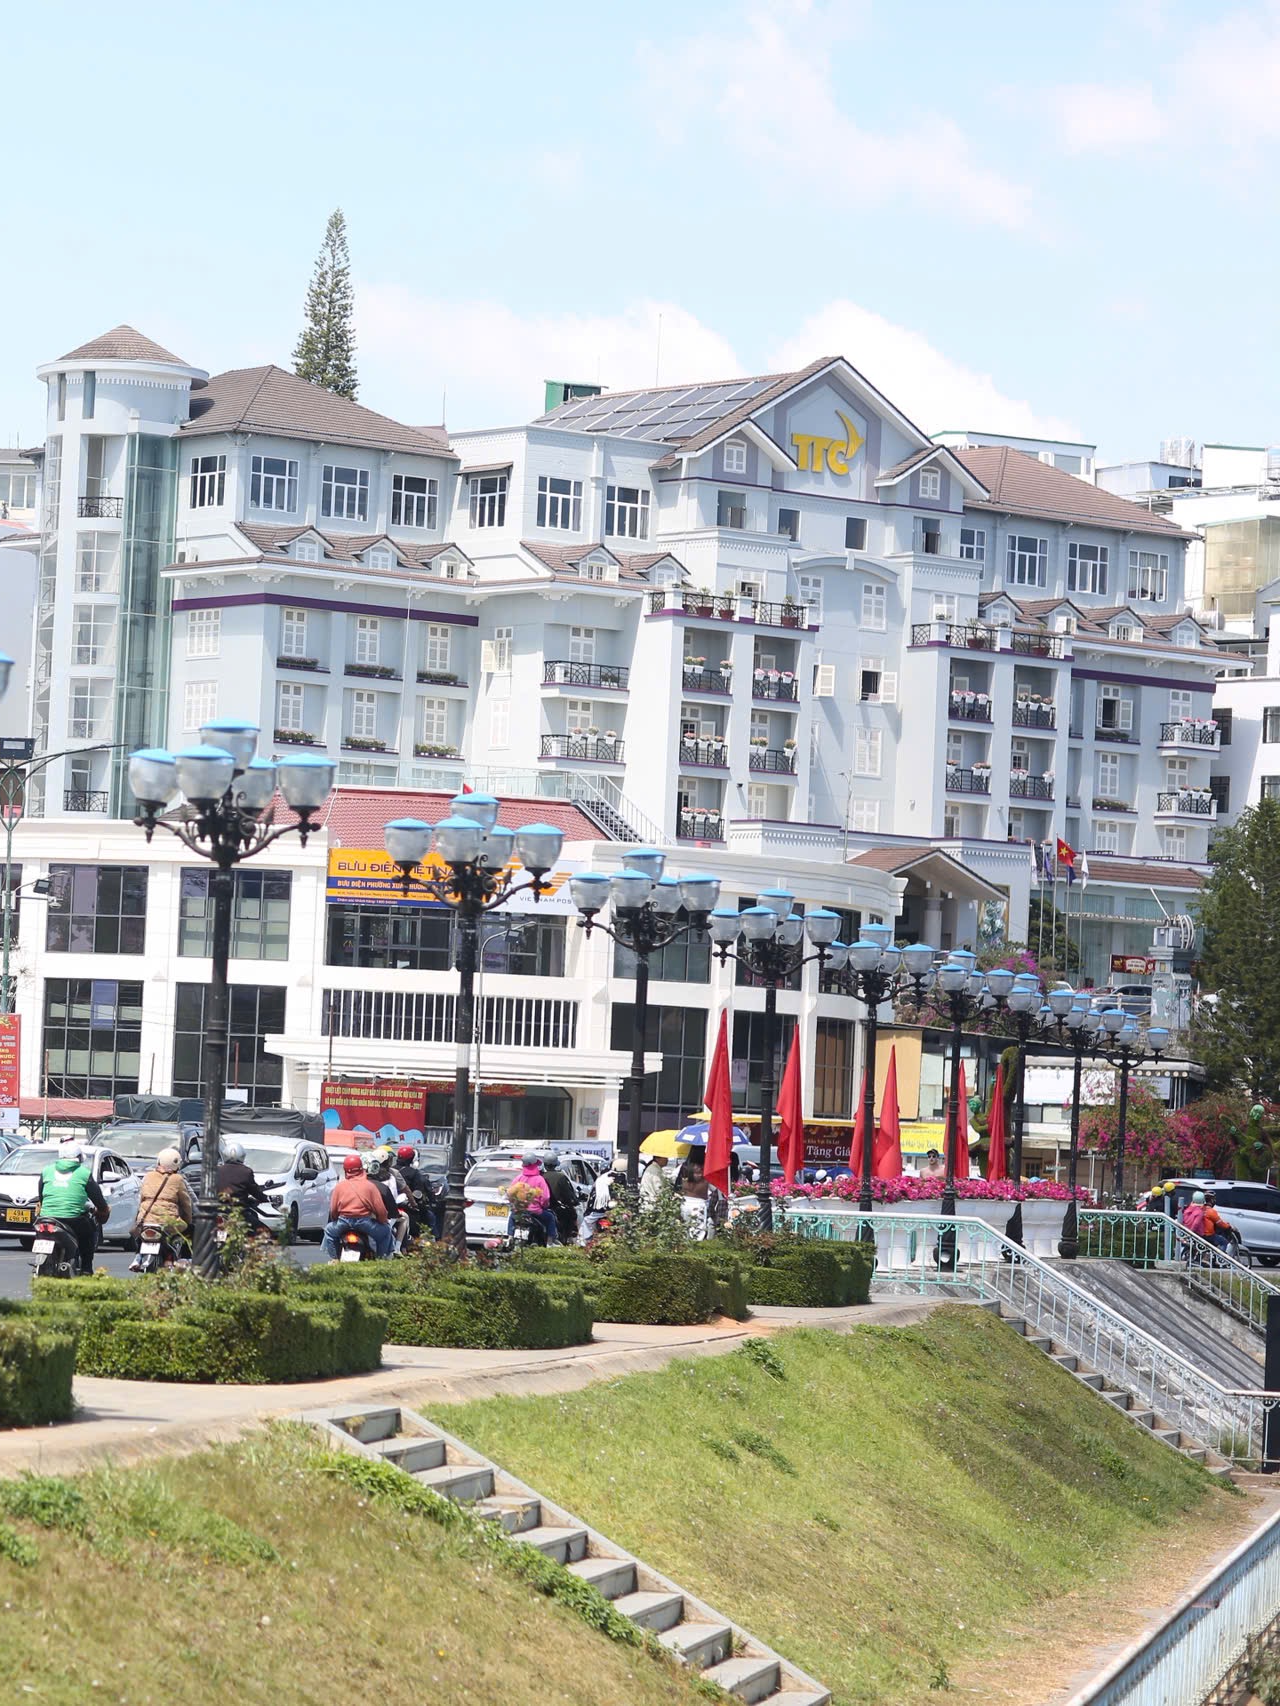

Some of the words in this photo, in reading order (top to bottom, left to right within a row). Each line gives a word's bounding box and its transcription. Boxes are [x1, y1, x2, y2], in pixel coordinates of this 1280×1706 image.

[791, 432, 852, 476] TTC
[338, 860, 367, 872] BƯU
[370, 861, 401, 875] ĐIỆN
[807, 1144, 832, 1159] Tặng
